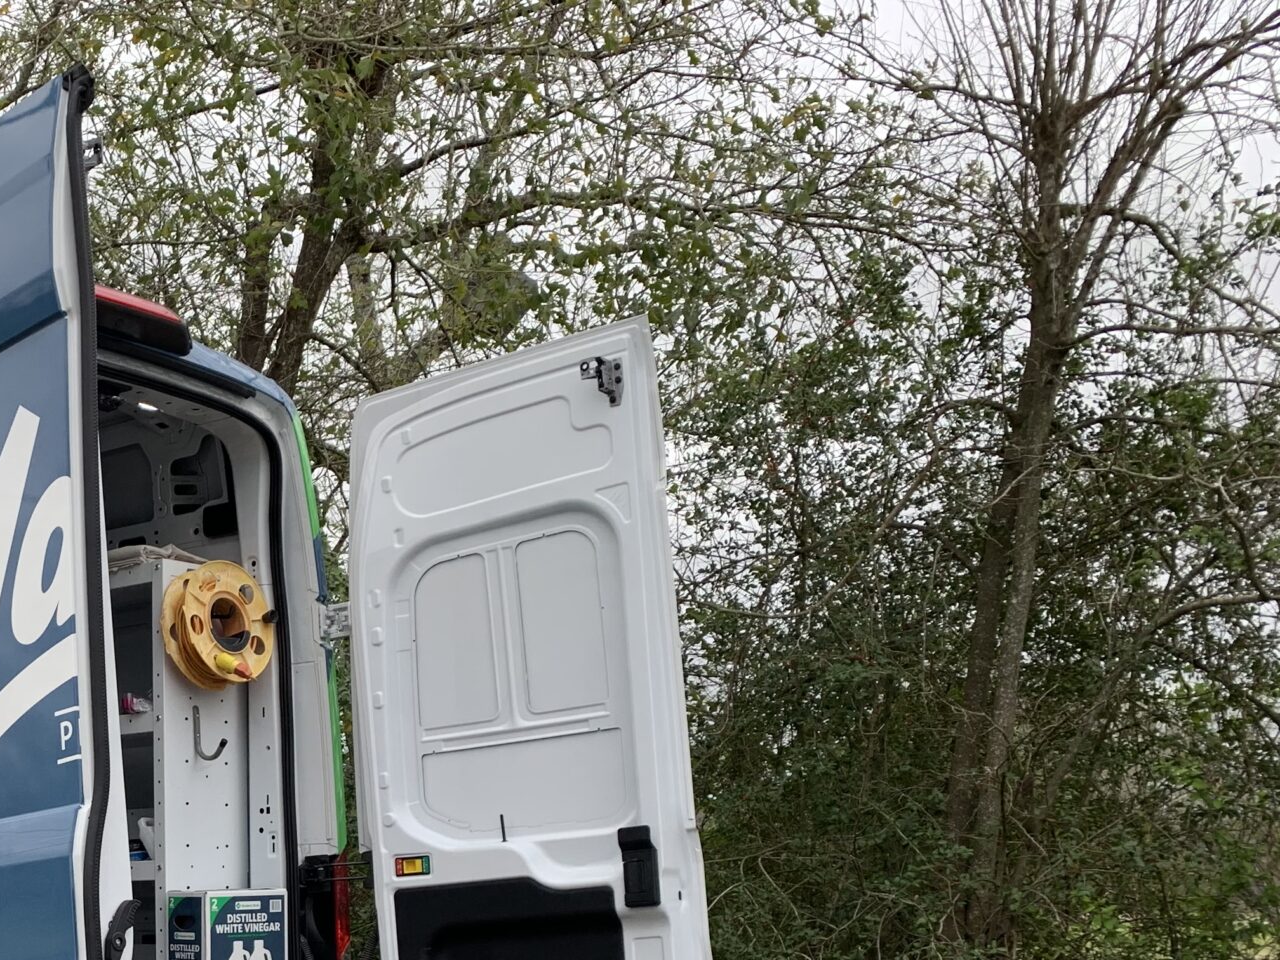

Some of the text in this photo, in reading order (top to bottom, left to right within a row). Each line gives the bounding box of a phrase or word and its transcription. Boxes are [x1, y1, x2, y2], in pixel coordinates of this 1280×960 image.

[211, 899, 218, 908] 2
[226, 913, 268, 923] DISTILLED
[215, 922, 281, 934] WHITE VINEGAR
[170, 944, 200, 953] DISTILLED
[174, 952, 195, 960] WHITE
